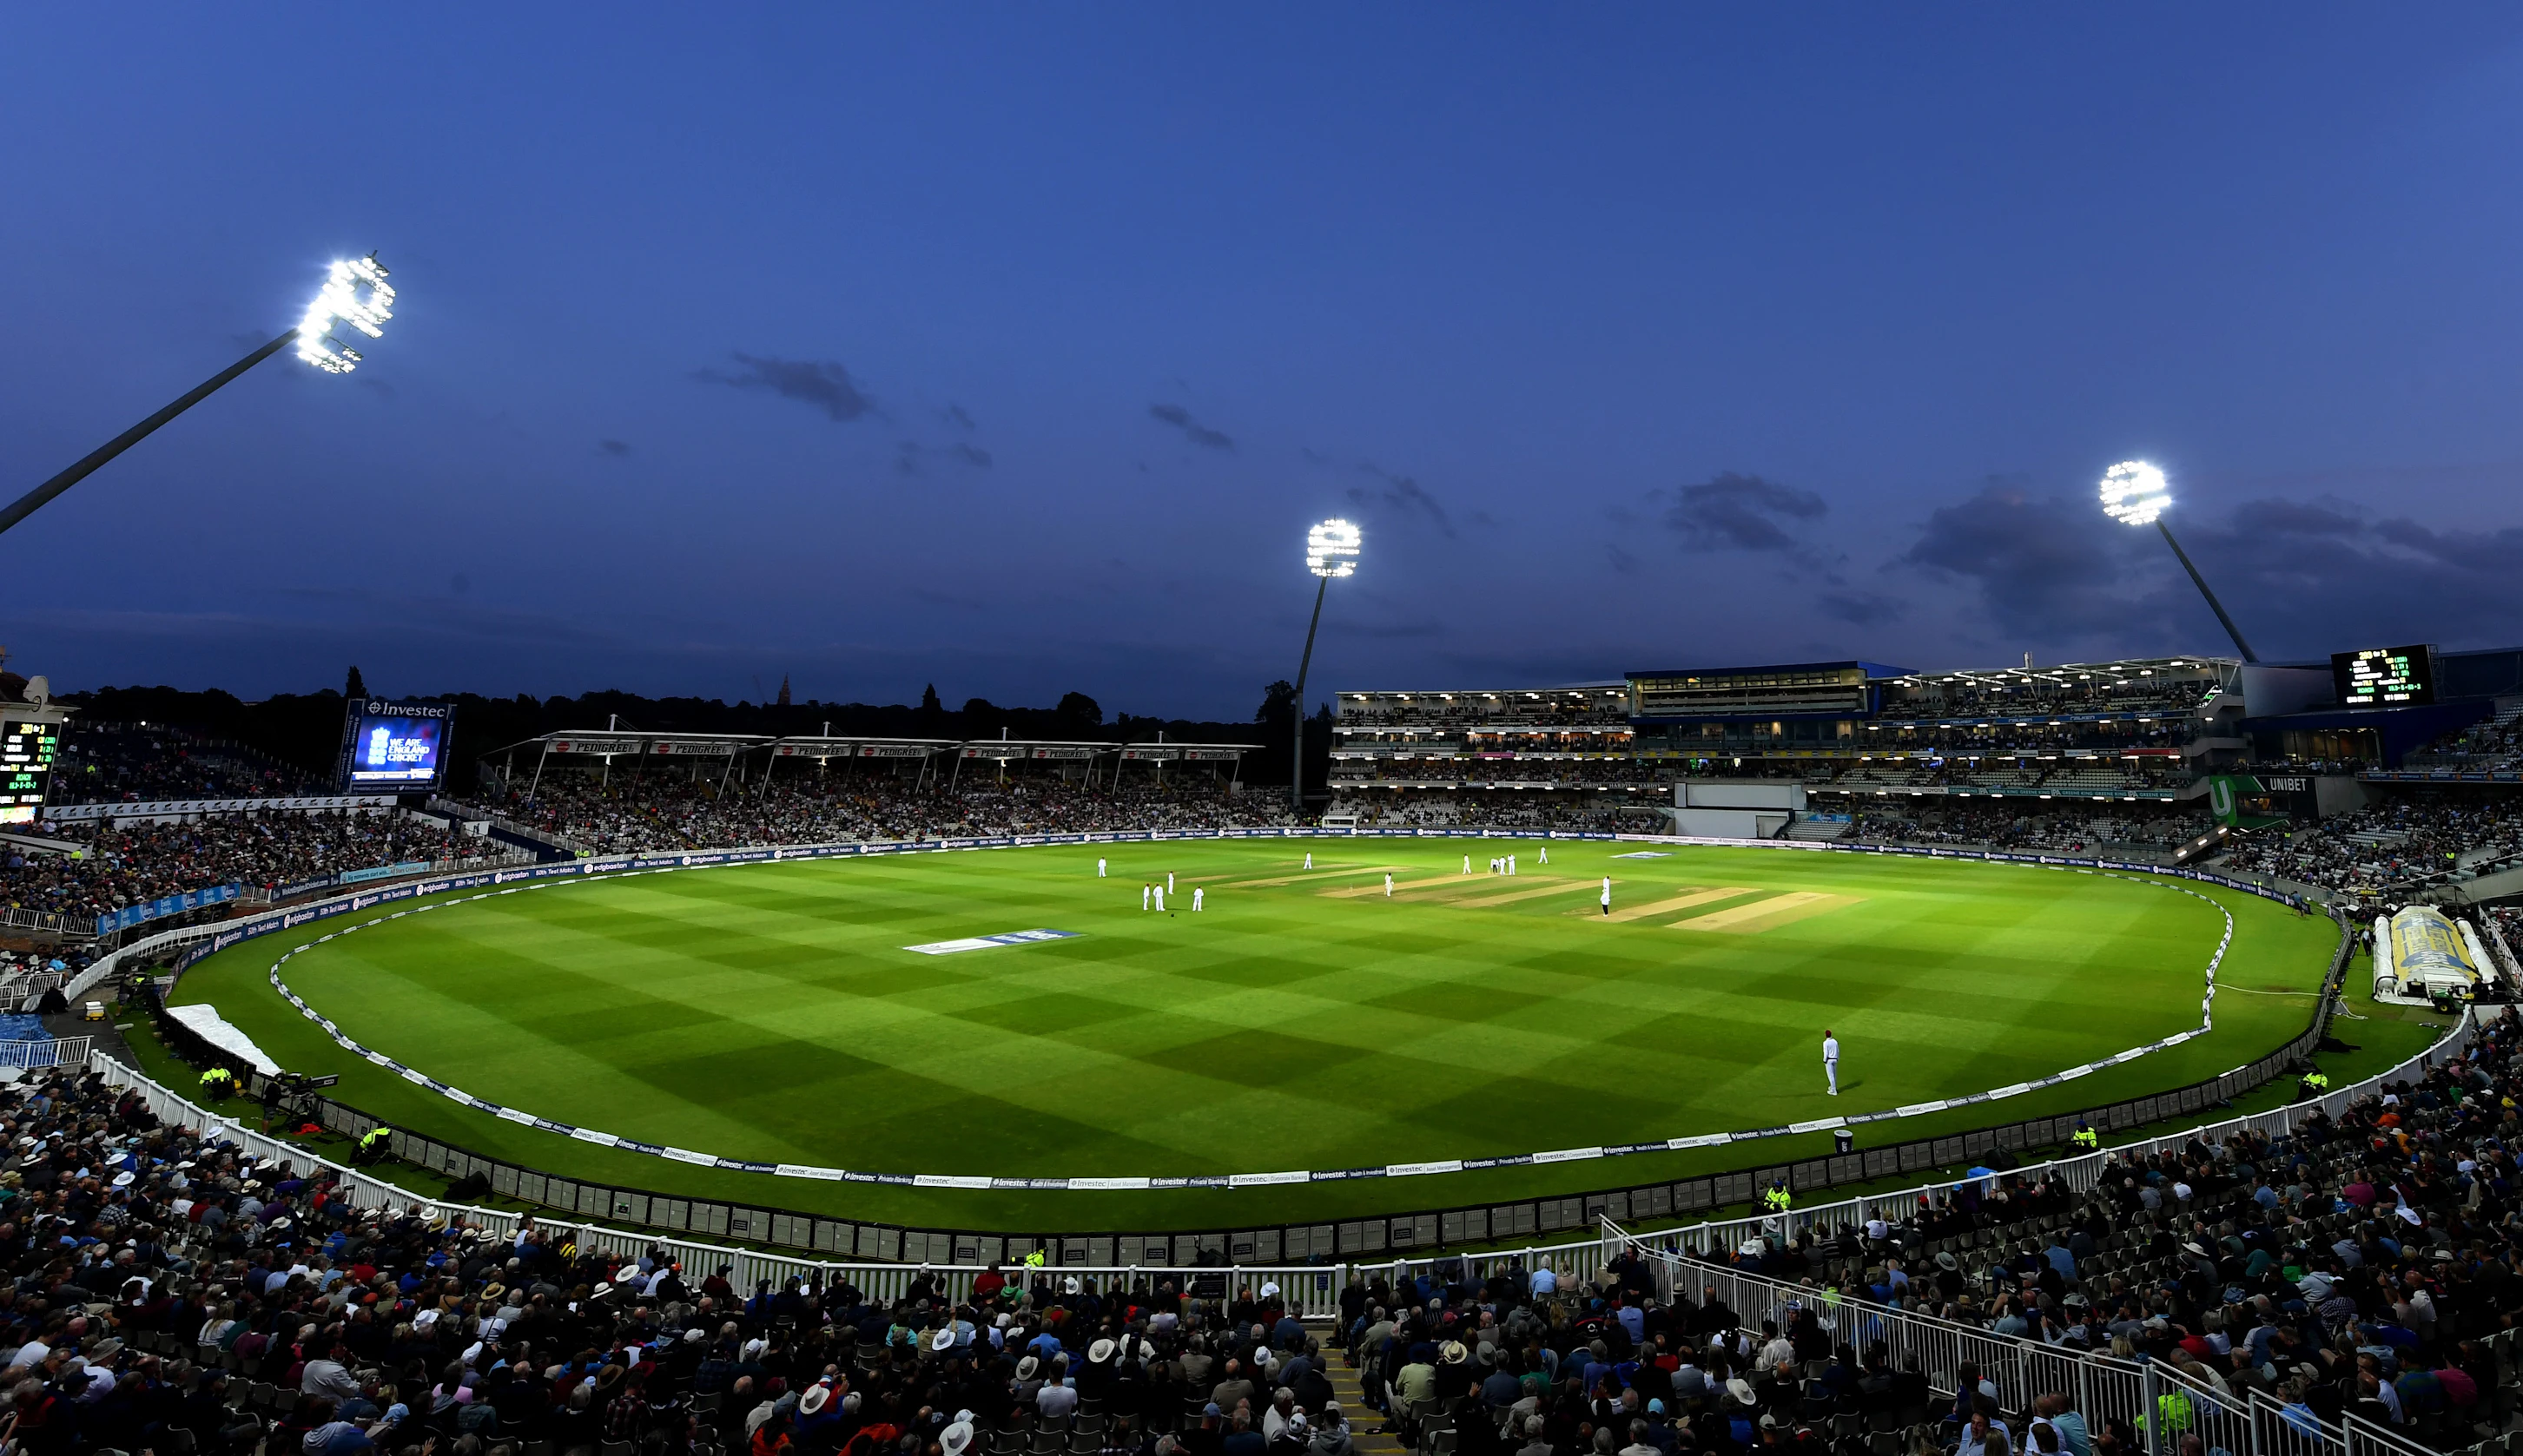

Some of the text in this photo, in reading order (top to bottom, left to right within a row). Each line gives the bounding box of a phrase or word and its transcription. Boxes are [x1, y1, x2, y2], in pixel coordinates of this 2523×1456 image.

[2381, 649, 2387, 658] 3
[383, 702, 445, 717] Investec
[39, 725, 45, 734] 3
[575, 743, 628, 752] PEDIGREE
[675, 744, 722, 754] PEDIGREE
[2270, 777, 2306, 791] UNIBET
[2210, 780, 2231, 817] U
[868, 844, 897, 853] edgbaston
[783, 849, 812, 858] edgbaston
[691, 855, 723, 863] edgbaston
[594, 862, 627, 872] edgbaston
[502, 871, 529, 883] edgbaston
[423, 882, 450, 893] edgbaston
[455, 879, 466, 887] 50th
[204, 888, 214, 896] Exotic
[391, 891, 400, 899] Test
[400, 889, 412, 897] Match
[160, 899, 172, 907] Exotic
[359, 896, 379, 906] edgbaston
[160, 907, 172, 916] Drinks
[337, 903, 349, 912] Match
[289, 911, 315, 925] edgbaston
[257, 924, 266, 933] Test
[266, 921, 279, 930] Match
[220, 931, 242, 946] edgbaston
[1951, 1097, 1969, 1106] Investec
[1902, 1107, 1922, 1115] Investec
[1852, 1114, 1872, 1123] Investec
[1796, 1122, 1817, 1130] Investec
[1737, 1131, 1759, 1140] Investec
[1774, 1127, 1790, 1136] Banking
[621, 1140, 638, 1150] Investec
[1675, 1138, 1699, 1146] Investec
[668, 1149, 688, 1160] Investec
[1608, 1146, 1634, 1154] Investec
[1540, 1153, 1566, 1161] Investec
[1569, 1151, 1587, 1159] Corporate
[721, 1160, 744, 1169] Investec
[1395, 1165, 1423, 1174] Investec
[1437, 1163, 1460, 1172] Management
[1469, 1160, 1496, 1168] Investec
[783, 1166, 808, 1175] Investec
[850, 1173, 913, 1185] Investec Private Banking
[1238, 1176, 1268, 1184] Investec
[1291, 1174, 1308, 1182] Banking
[1318, 1171, 1347, 1180] Investec
[922, 1176, 950, 1185] Investec
[998, 1179, 1027, 1187] Investec
[1157, 1178, 1228, 1186] Investec Private Banking
